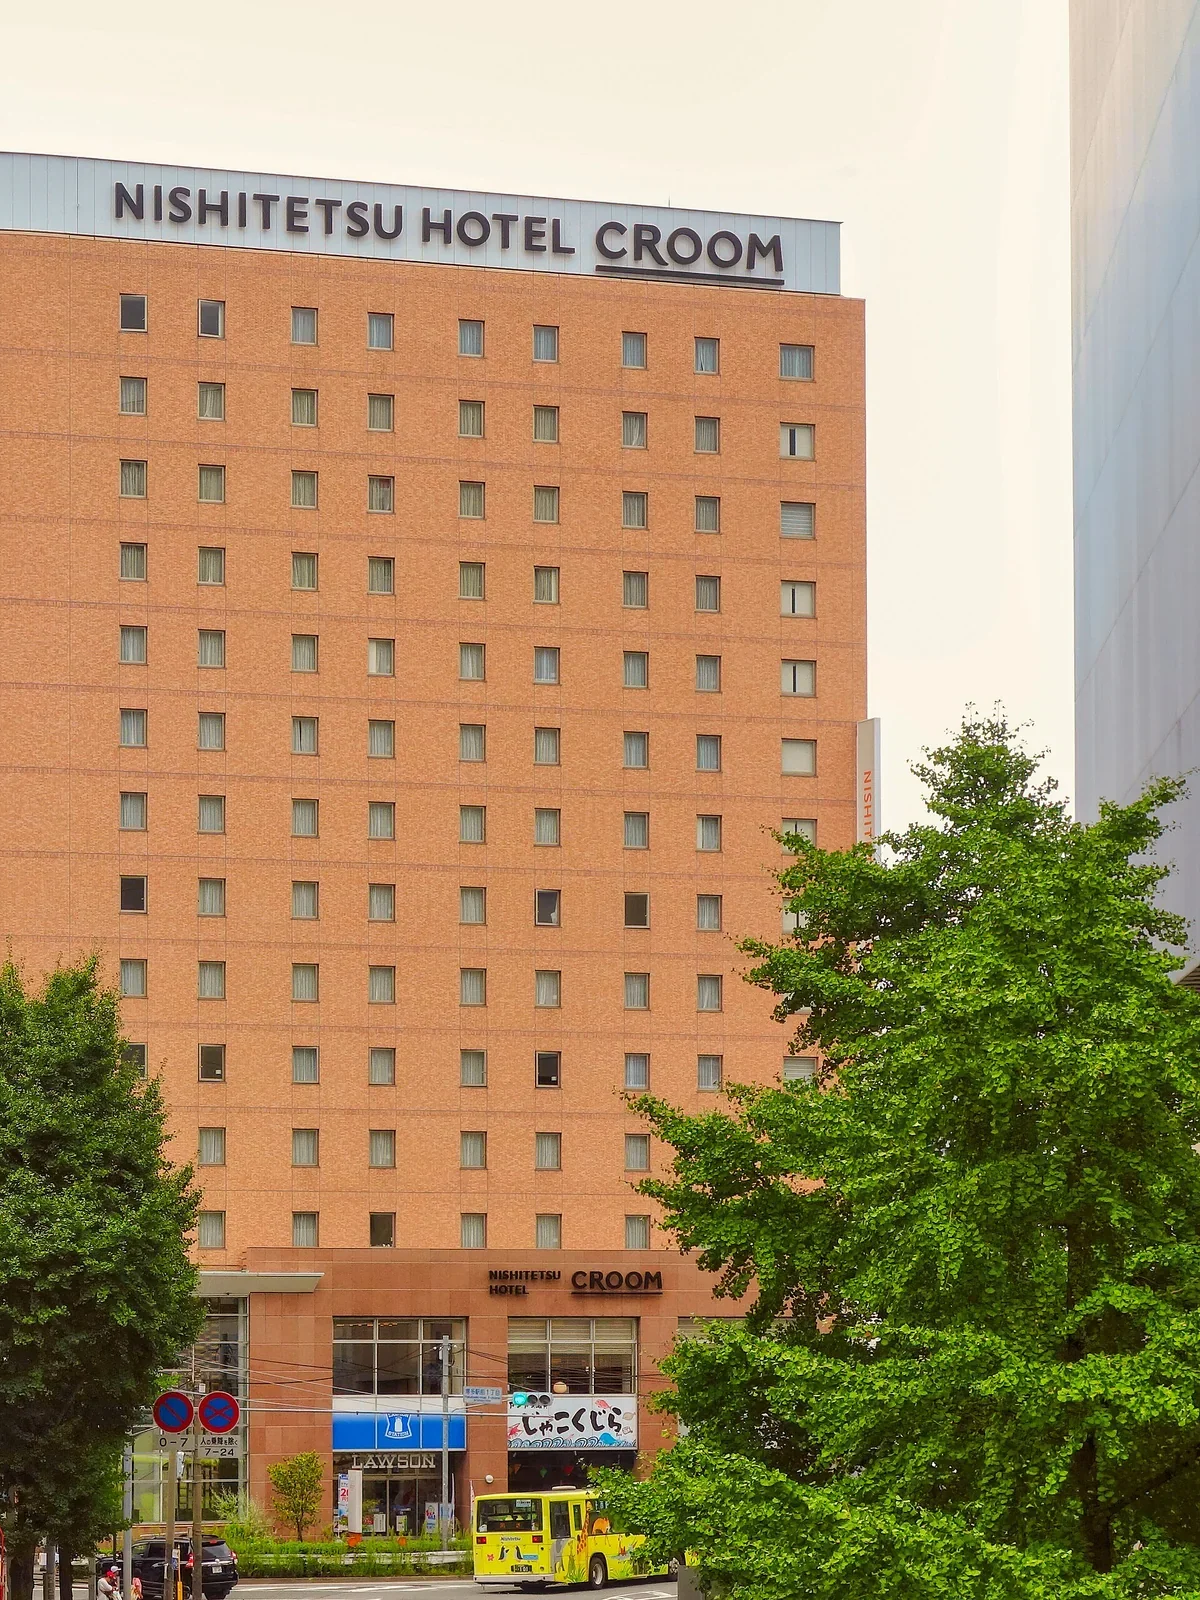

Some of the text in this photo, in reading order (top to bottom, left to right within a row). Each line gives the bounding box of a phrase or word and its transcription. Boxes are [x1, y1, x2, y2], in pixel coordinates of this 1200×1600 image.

[114, 182, 784, 272] NISHITETSU HOTEL CROOM
[489, 1270, 663, 1290] NISHITETSU CROOM
[489, 1284, 530, 1295] HOTEL
[521, 1407, 622, 1436] じゃこくじら
[388, 1430, 410, 1438] STATION
[159, 1437, 189, 1448] 0-7
[200, 1436, 238, 1446] 人の乗降を除く
[204, 1447, 234, 1457] 7-24
[351, 1453, 436, 1469] LAWSON
